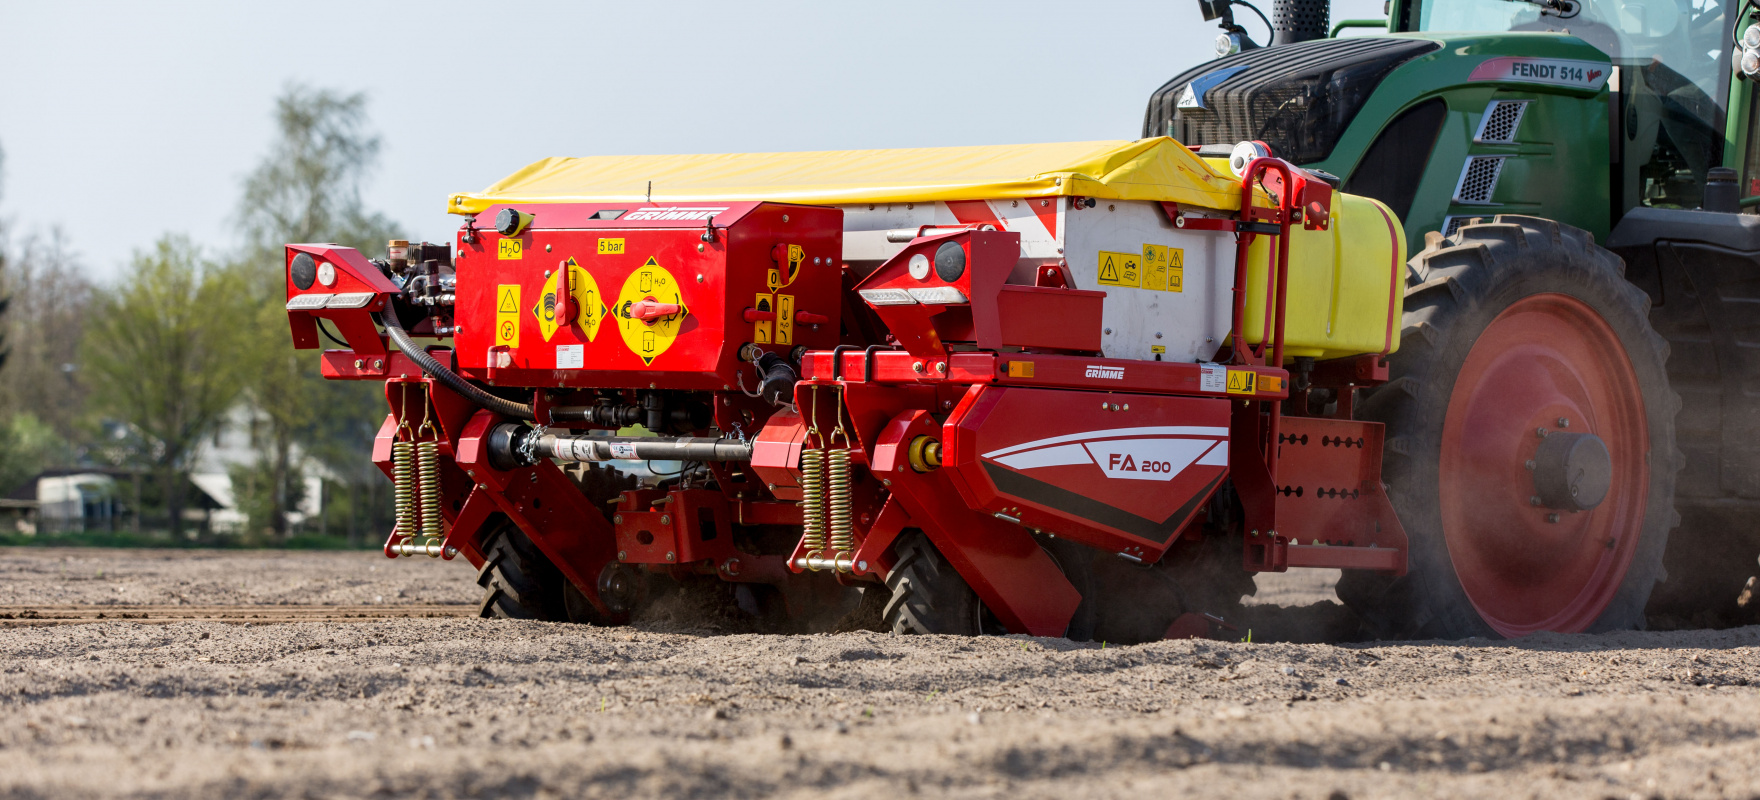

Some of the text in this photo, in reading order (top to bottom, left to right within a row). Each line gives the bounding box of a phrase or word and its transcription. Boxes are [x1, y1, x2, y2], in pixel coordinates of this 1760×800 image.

[1511, 62, 1556, 79] FENDT
[1560, 66, 1583, 81] 514
[623, 206, 724, 221] GRIMME
[599, 241, 623, 252] 5 bar
[1085, 365, 1125, 380] GRIMME
[1109, 453, 1172, 474] FA 200
